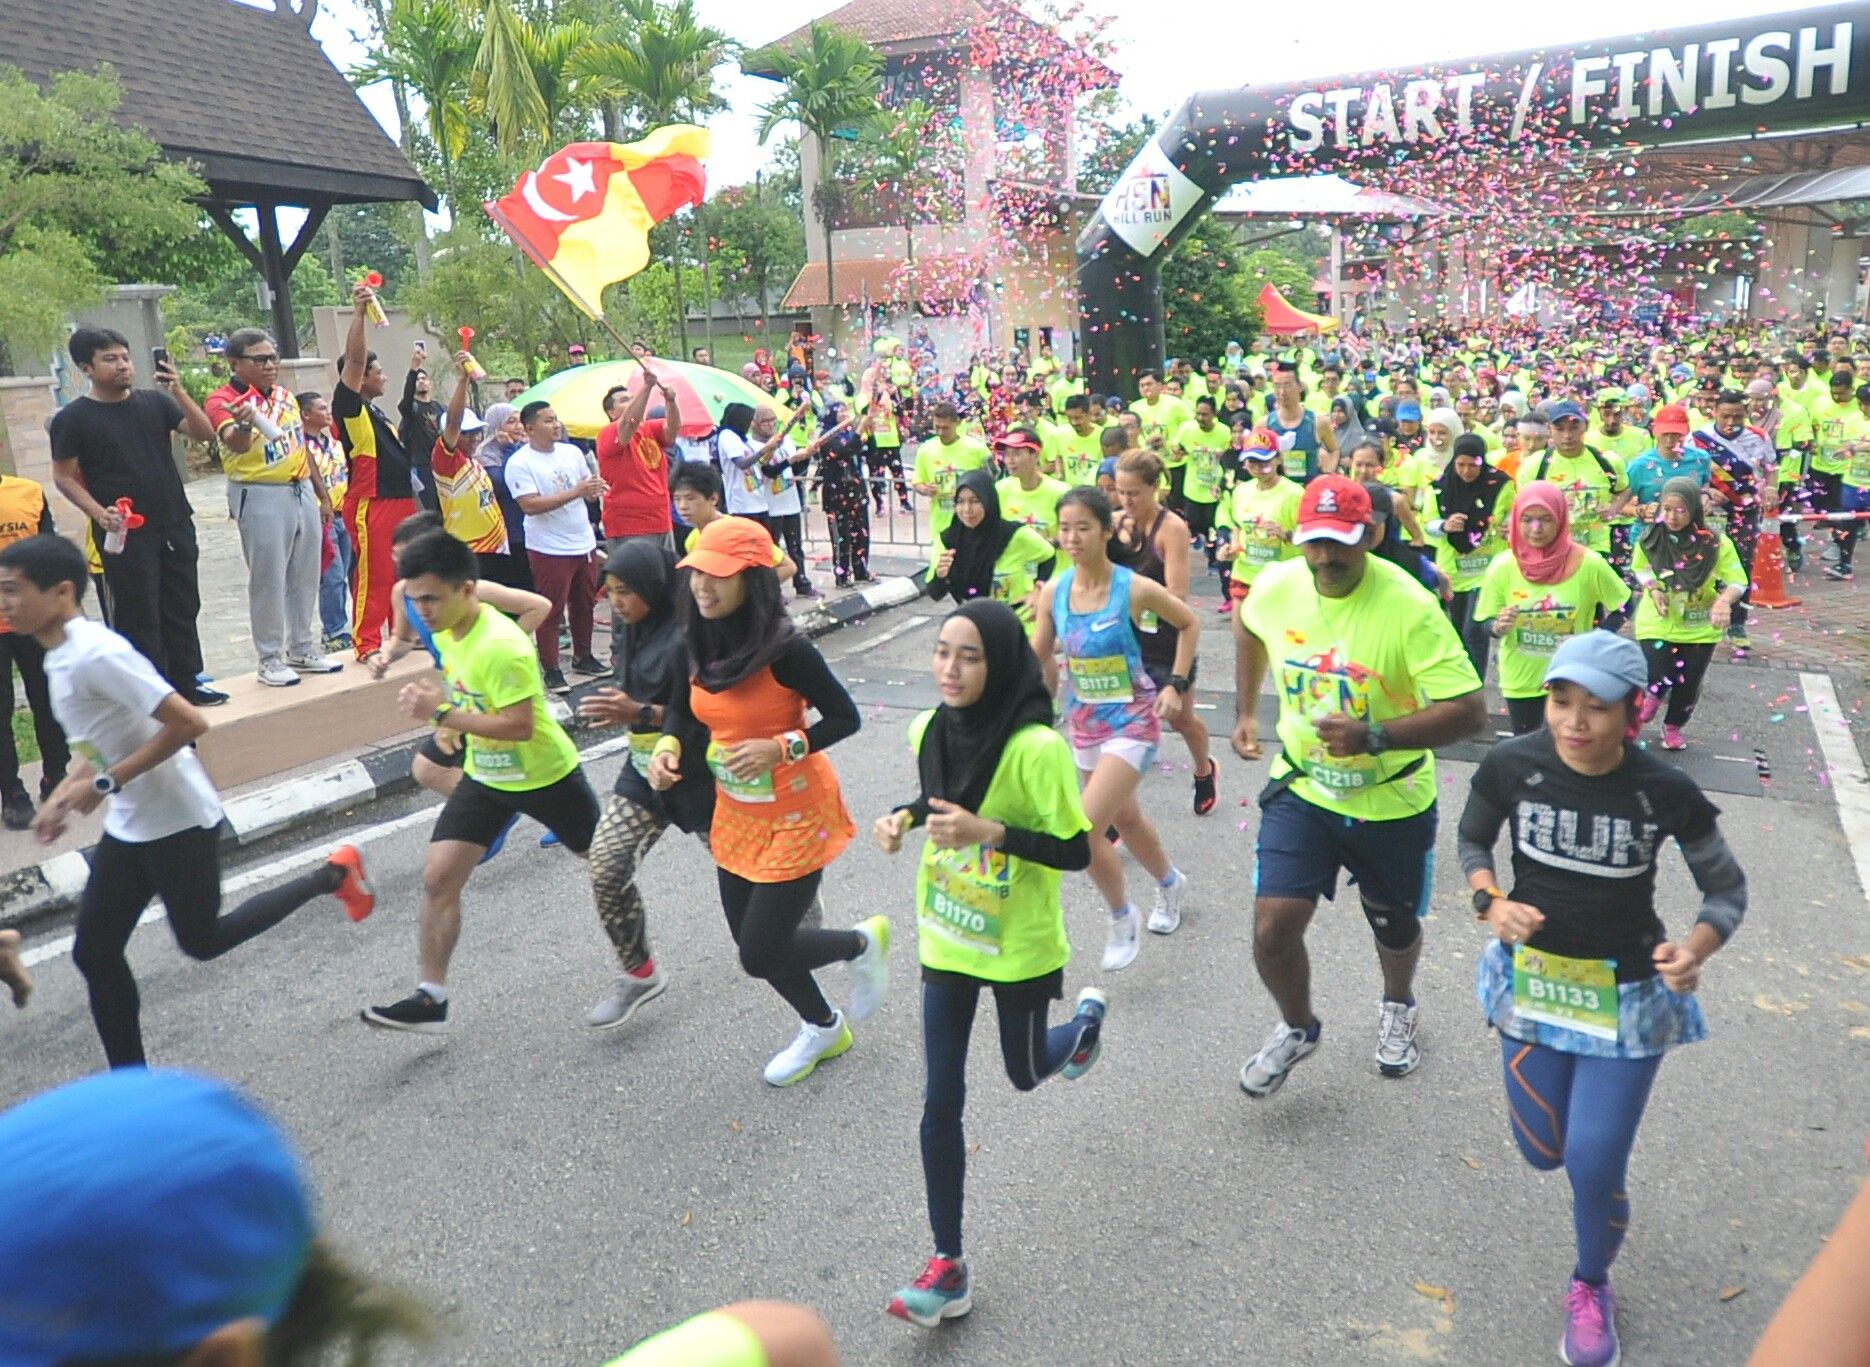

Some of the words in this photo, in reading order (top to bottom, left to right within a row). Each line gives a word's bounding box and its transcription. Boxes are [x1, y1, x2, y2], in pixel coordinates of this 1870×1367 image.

[1289, 72, 1486, 153] START
[1509, 62, 1545, 142] /
[1571, 21, 1854, 126] FINISH
[1113, 211, 1140, 225] HILL
[1144, 210, 1172, 224] RUN
[1522, 632, 1559, 646] D126
[1080, 675, 1121, 690] B1173
[1312, 765, 1365, 787] C1218
[1518, 800, 1658, 866] RUN
[933, 892, 985, 932] B1170
[1527, 977, 1600, 1010] B1133
